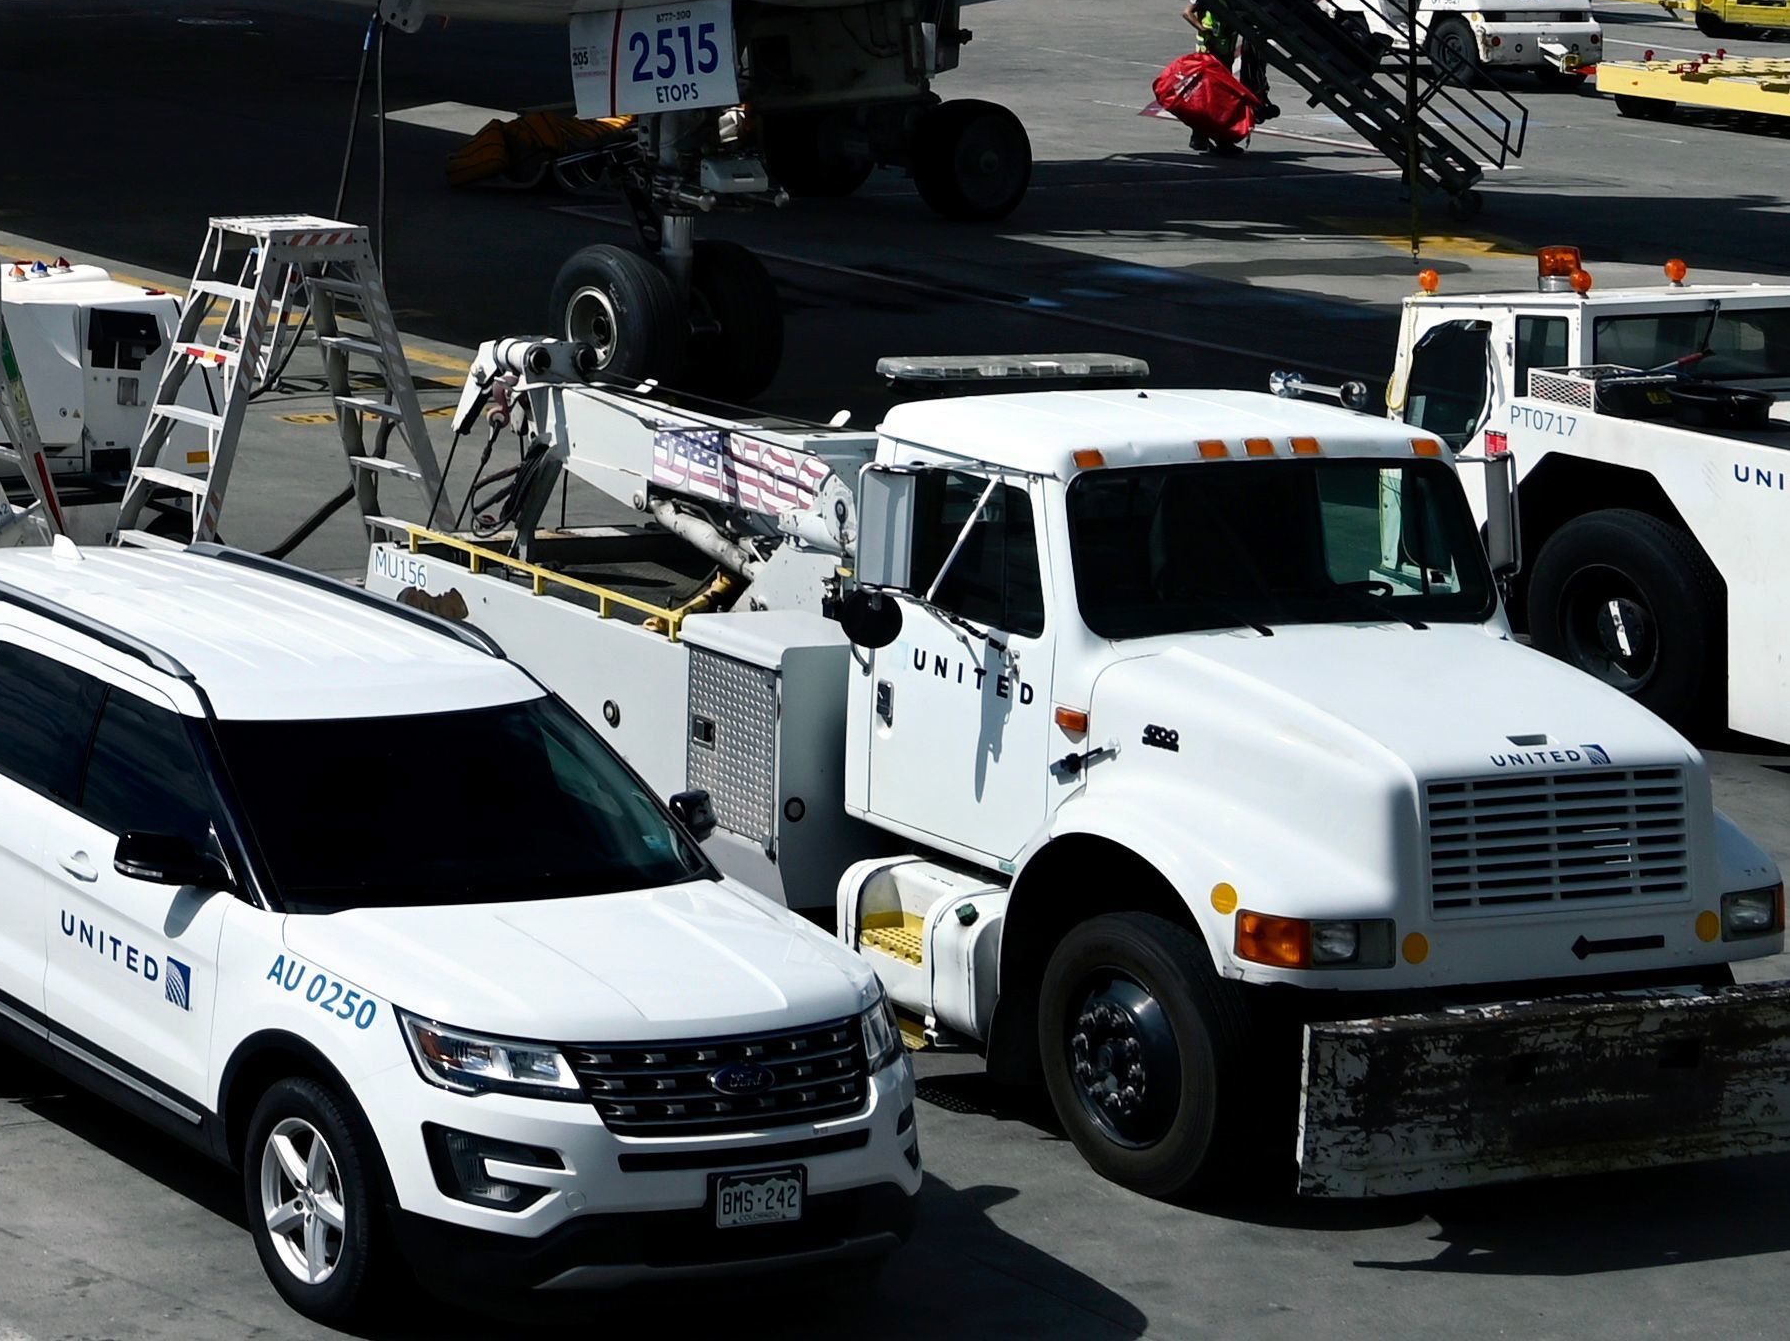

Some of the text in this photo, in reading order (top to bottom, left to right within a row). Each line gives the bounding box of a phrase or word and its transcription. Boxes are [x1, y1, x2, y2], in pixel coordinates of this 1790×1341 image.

[572, 51, 589, 66] 205
[629, 23, 718, 82] 2515
[655, 83, 699, 104] ETOPS
[1510, 405, 1577, 436] PT0717
[375, 550, 427, 588] MU156
[913, 648, 1034, 705] UNITED
[1490, 750, 1581, 766] UNITED
[61, 909, 159, 982] UNITED
[266, 954, 377, 1030] AU 0250
